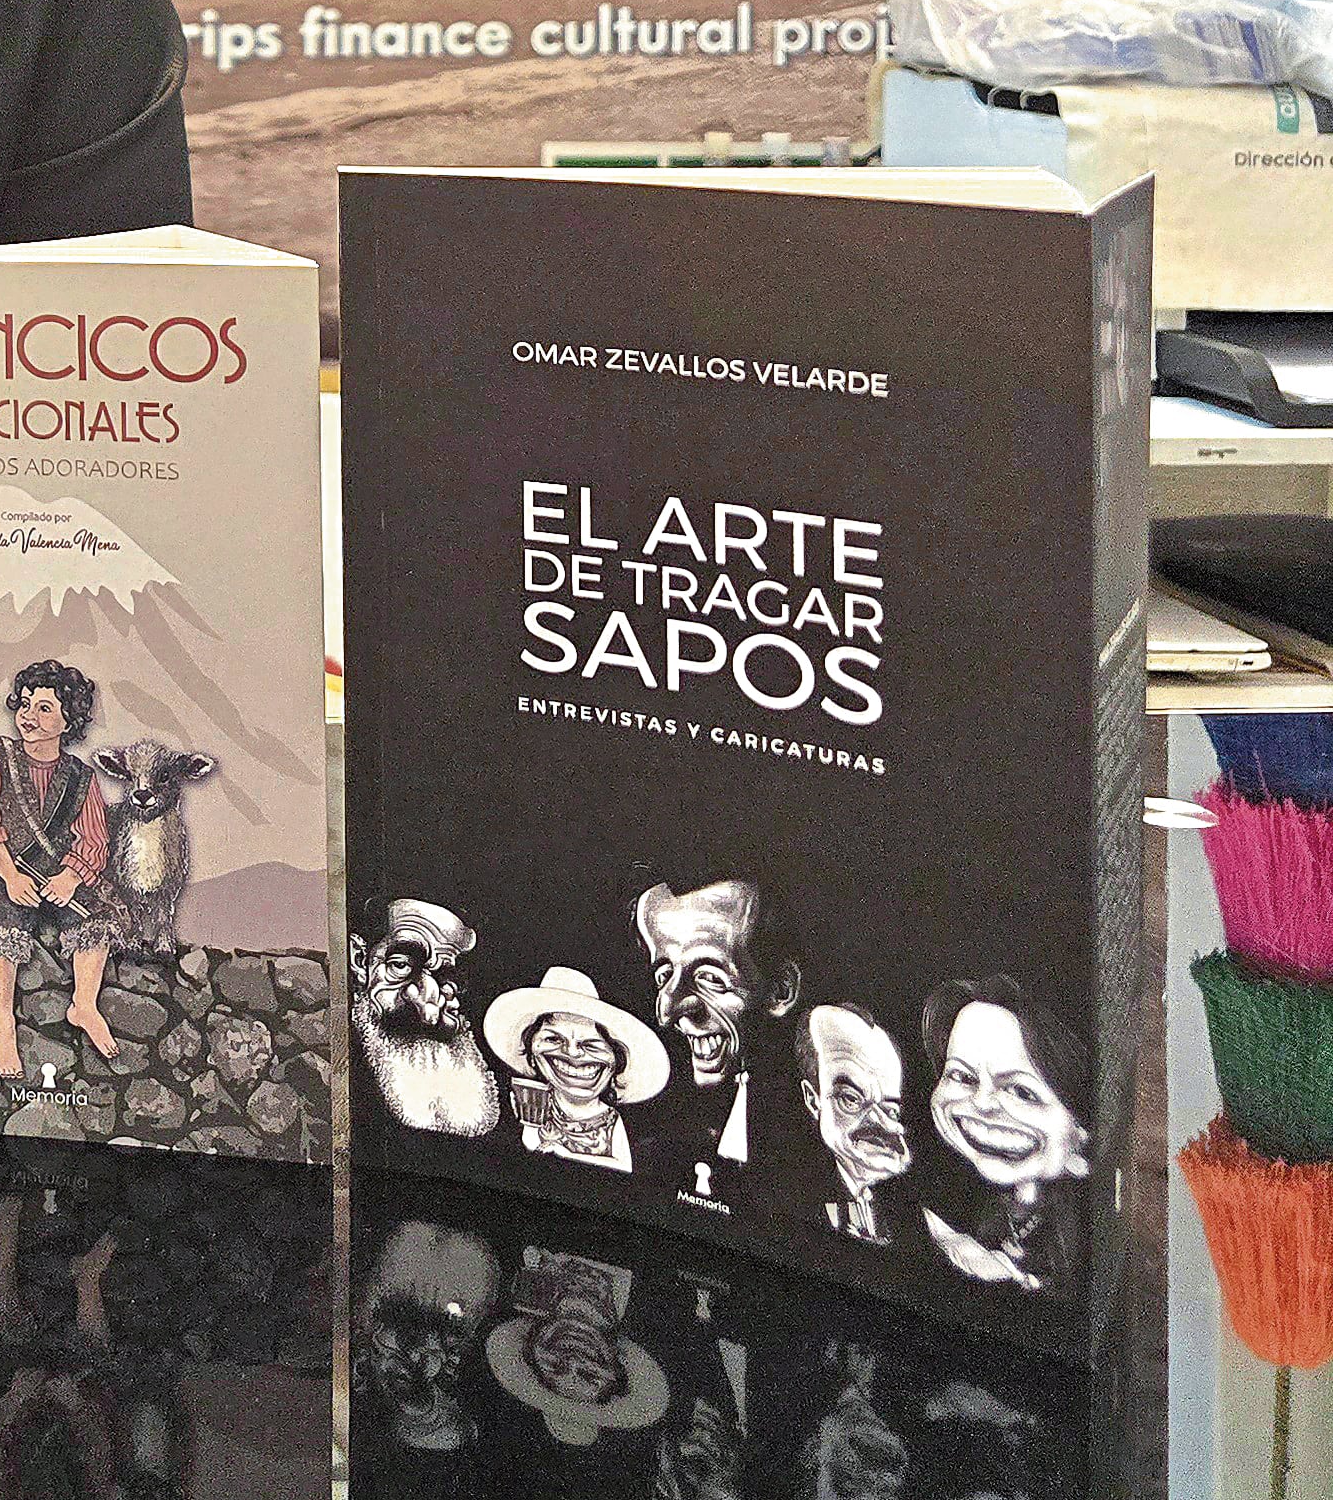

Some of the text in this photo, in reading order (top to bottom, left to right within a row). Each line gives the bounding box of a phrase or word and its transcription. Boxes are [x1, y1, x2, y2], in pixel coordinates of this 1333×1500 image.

[182, 1, 891, 73] rips finance cultural proj
[1235, 150, 1324, 167] Dirección
[512, 341, 890, 398] OMAR ZEVALLOS VELARDE
[24, 459, 180, 481] ADORADORES
[1, 510, 72, 525] Compilado por
[522, 480, 884, 589] EL ARTE
[9, 528, 73, 553] Valencia
[72, 529, 120, 556] Mena
[524, 548, 884, 645] DE TRAGAR
[519, 601, 884, 727] SAPOS
[518, 696, 886, 775] ENTREVISTAS Y CARICATURAS
[11, 1088, 88, 1106] Memoria
[677, 1189, 731, 1215] Memoria
